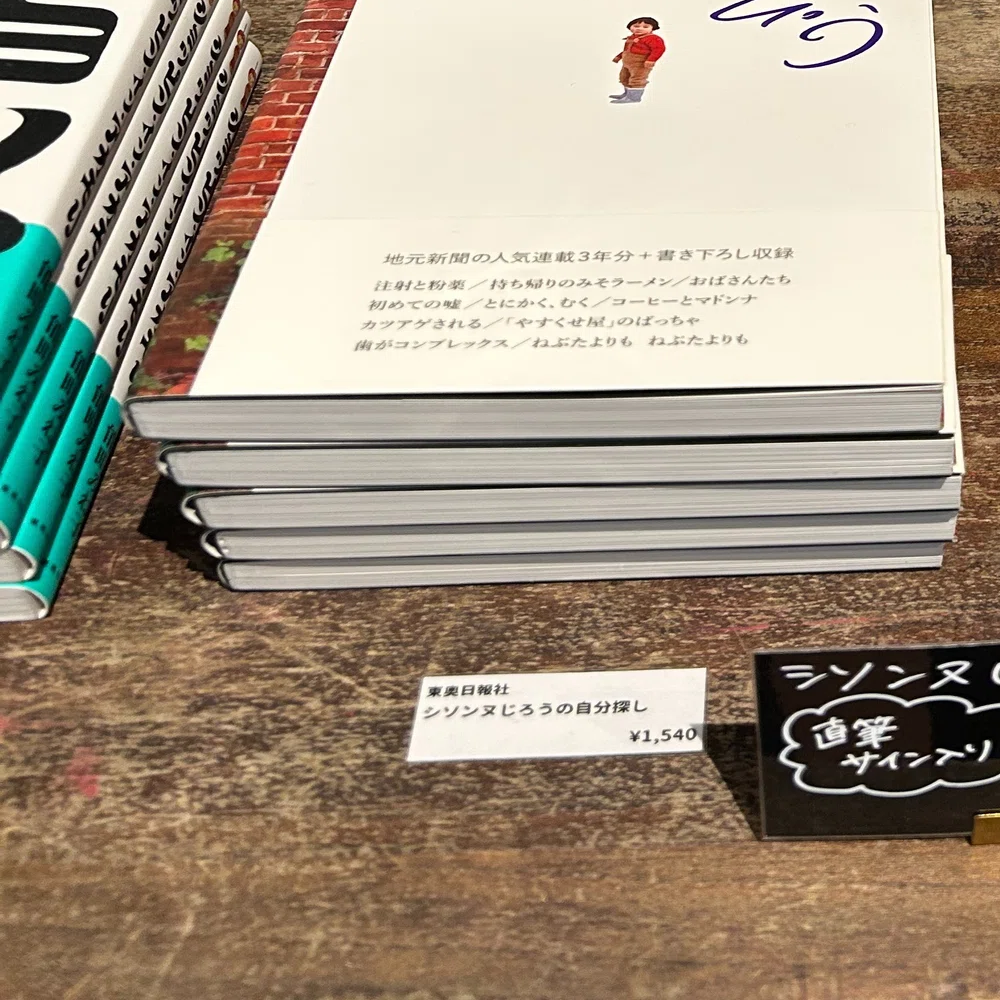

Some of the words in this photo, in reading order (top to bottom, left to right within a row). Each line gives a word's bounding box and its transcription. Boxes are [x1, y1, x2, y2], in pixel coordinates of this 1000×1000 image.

[426, 683, 511, 698] 東奥日報社
[422, 699, 648, 719] シソンヌじろうの自分探し
[629, 727, 698, 744] ¥1,540
[811, 715, 899, 750] 直筆
